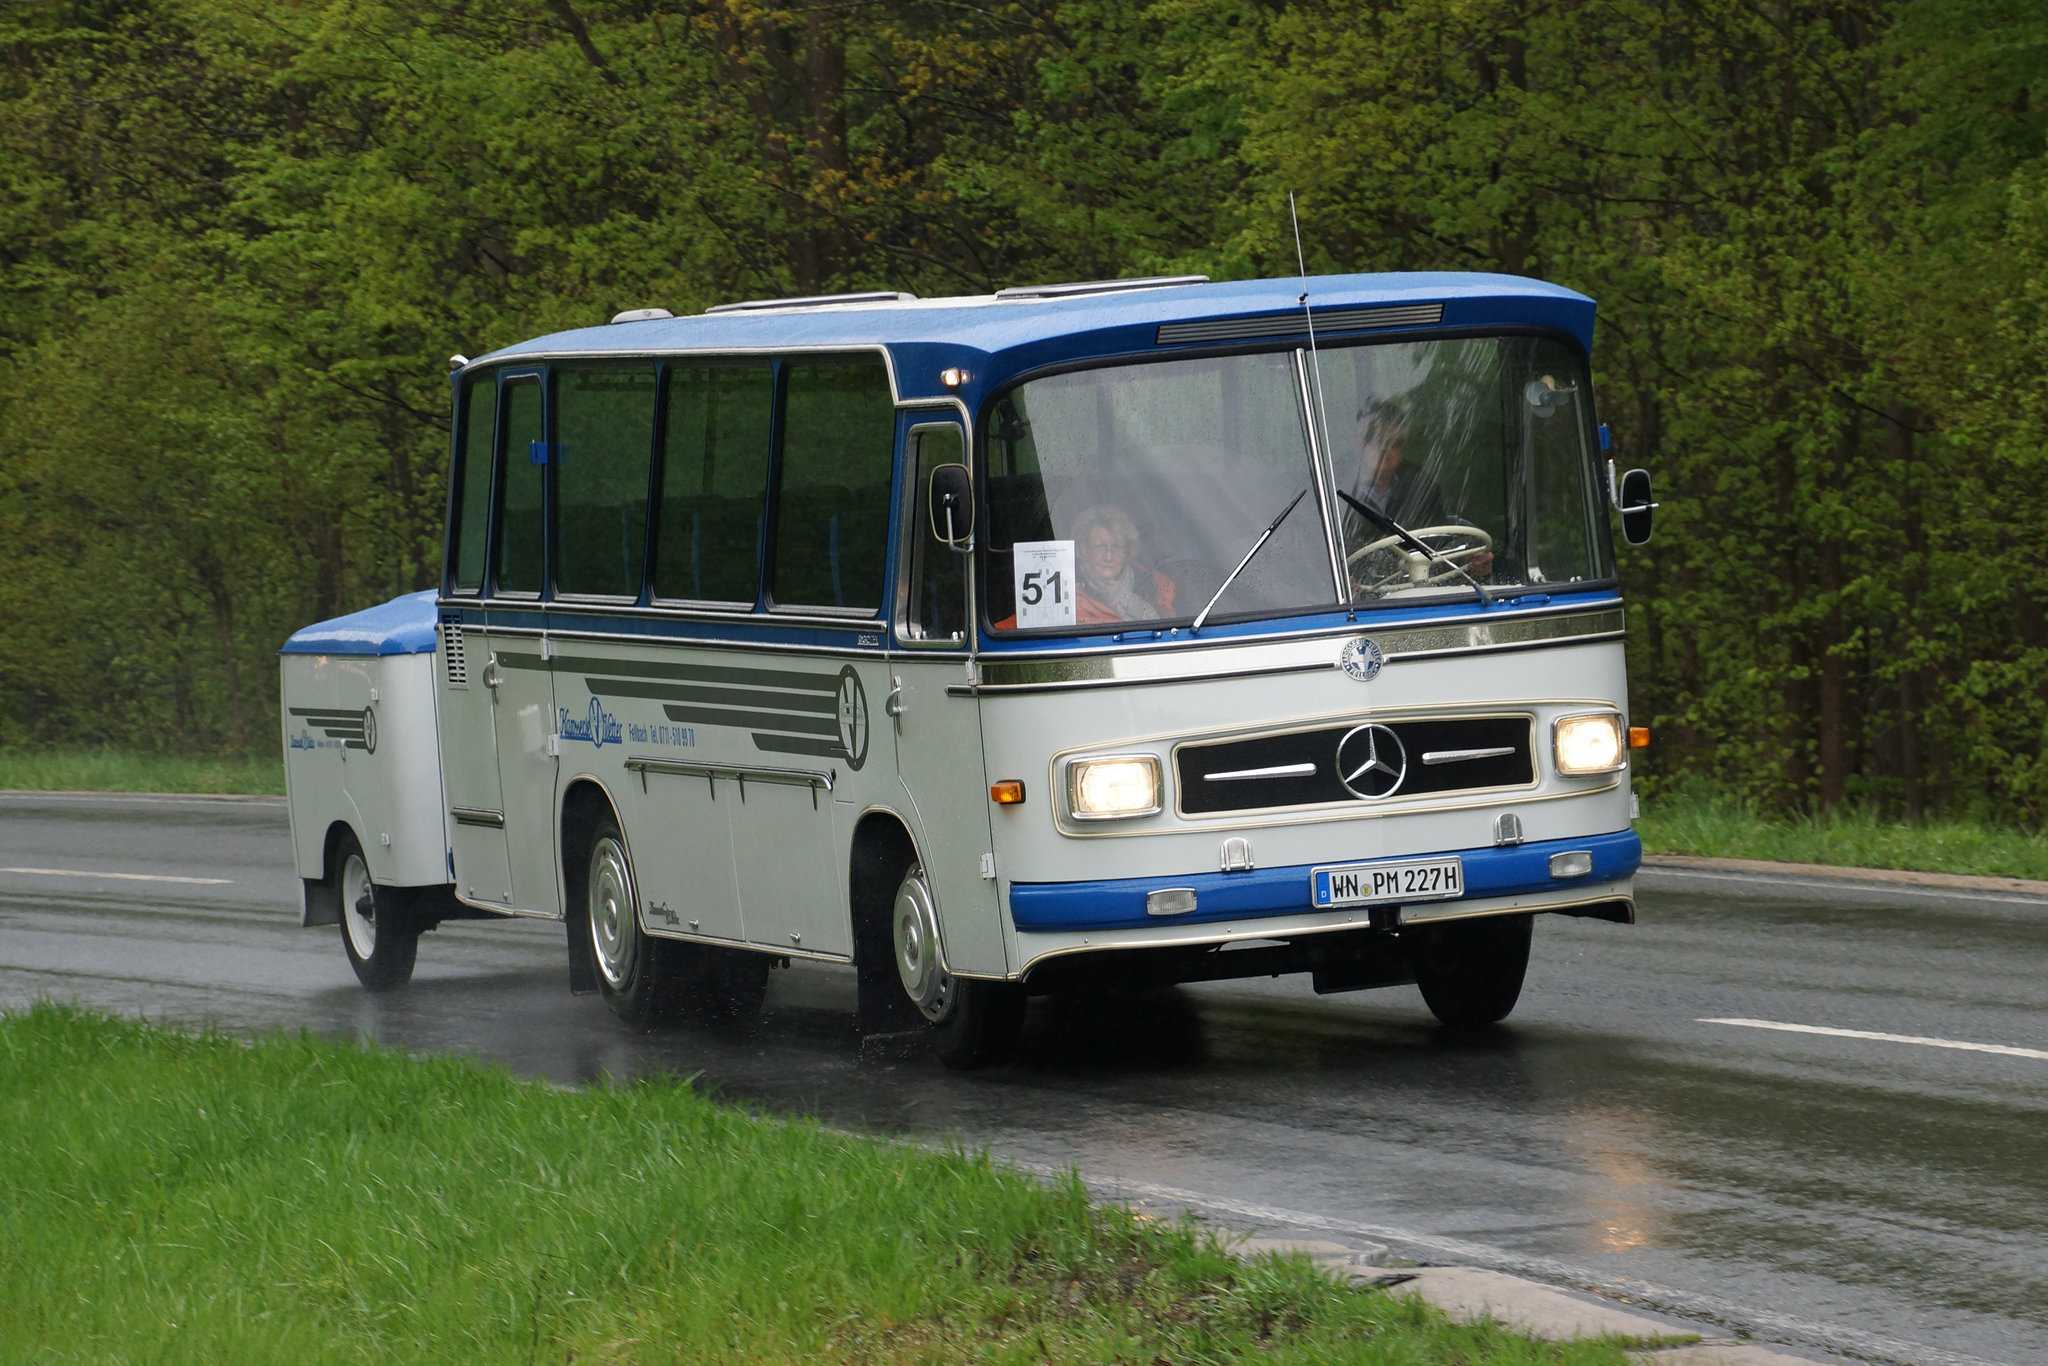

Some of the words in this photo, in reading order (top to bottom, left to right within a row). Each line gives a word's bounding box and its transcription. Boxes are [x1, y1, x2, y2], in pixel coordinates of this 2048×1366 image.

[1022, 571, 1061, 605] 51
[628, 723, 648, 742] Fellbach
[1321, 890, 1327, 899] D
[1332, 874, 1359, 898] WN
[1373, 871, 1400, 895] PM
